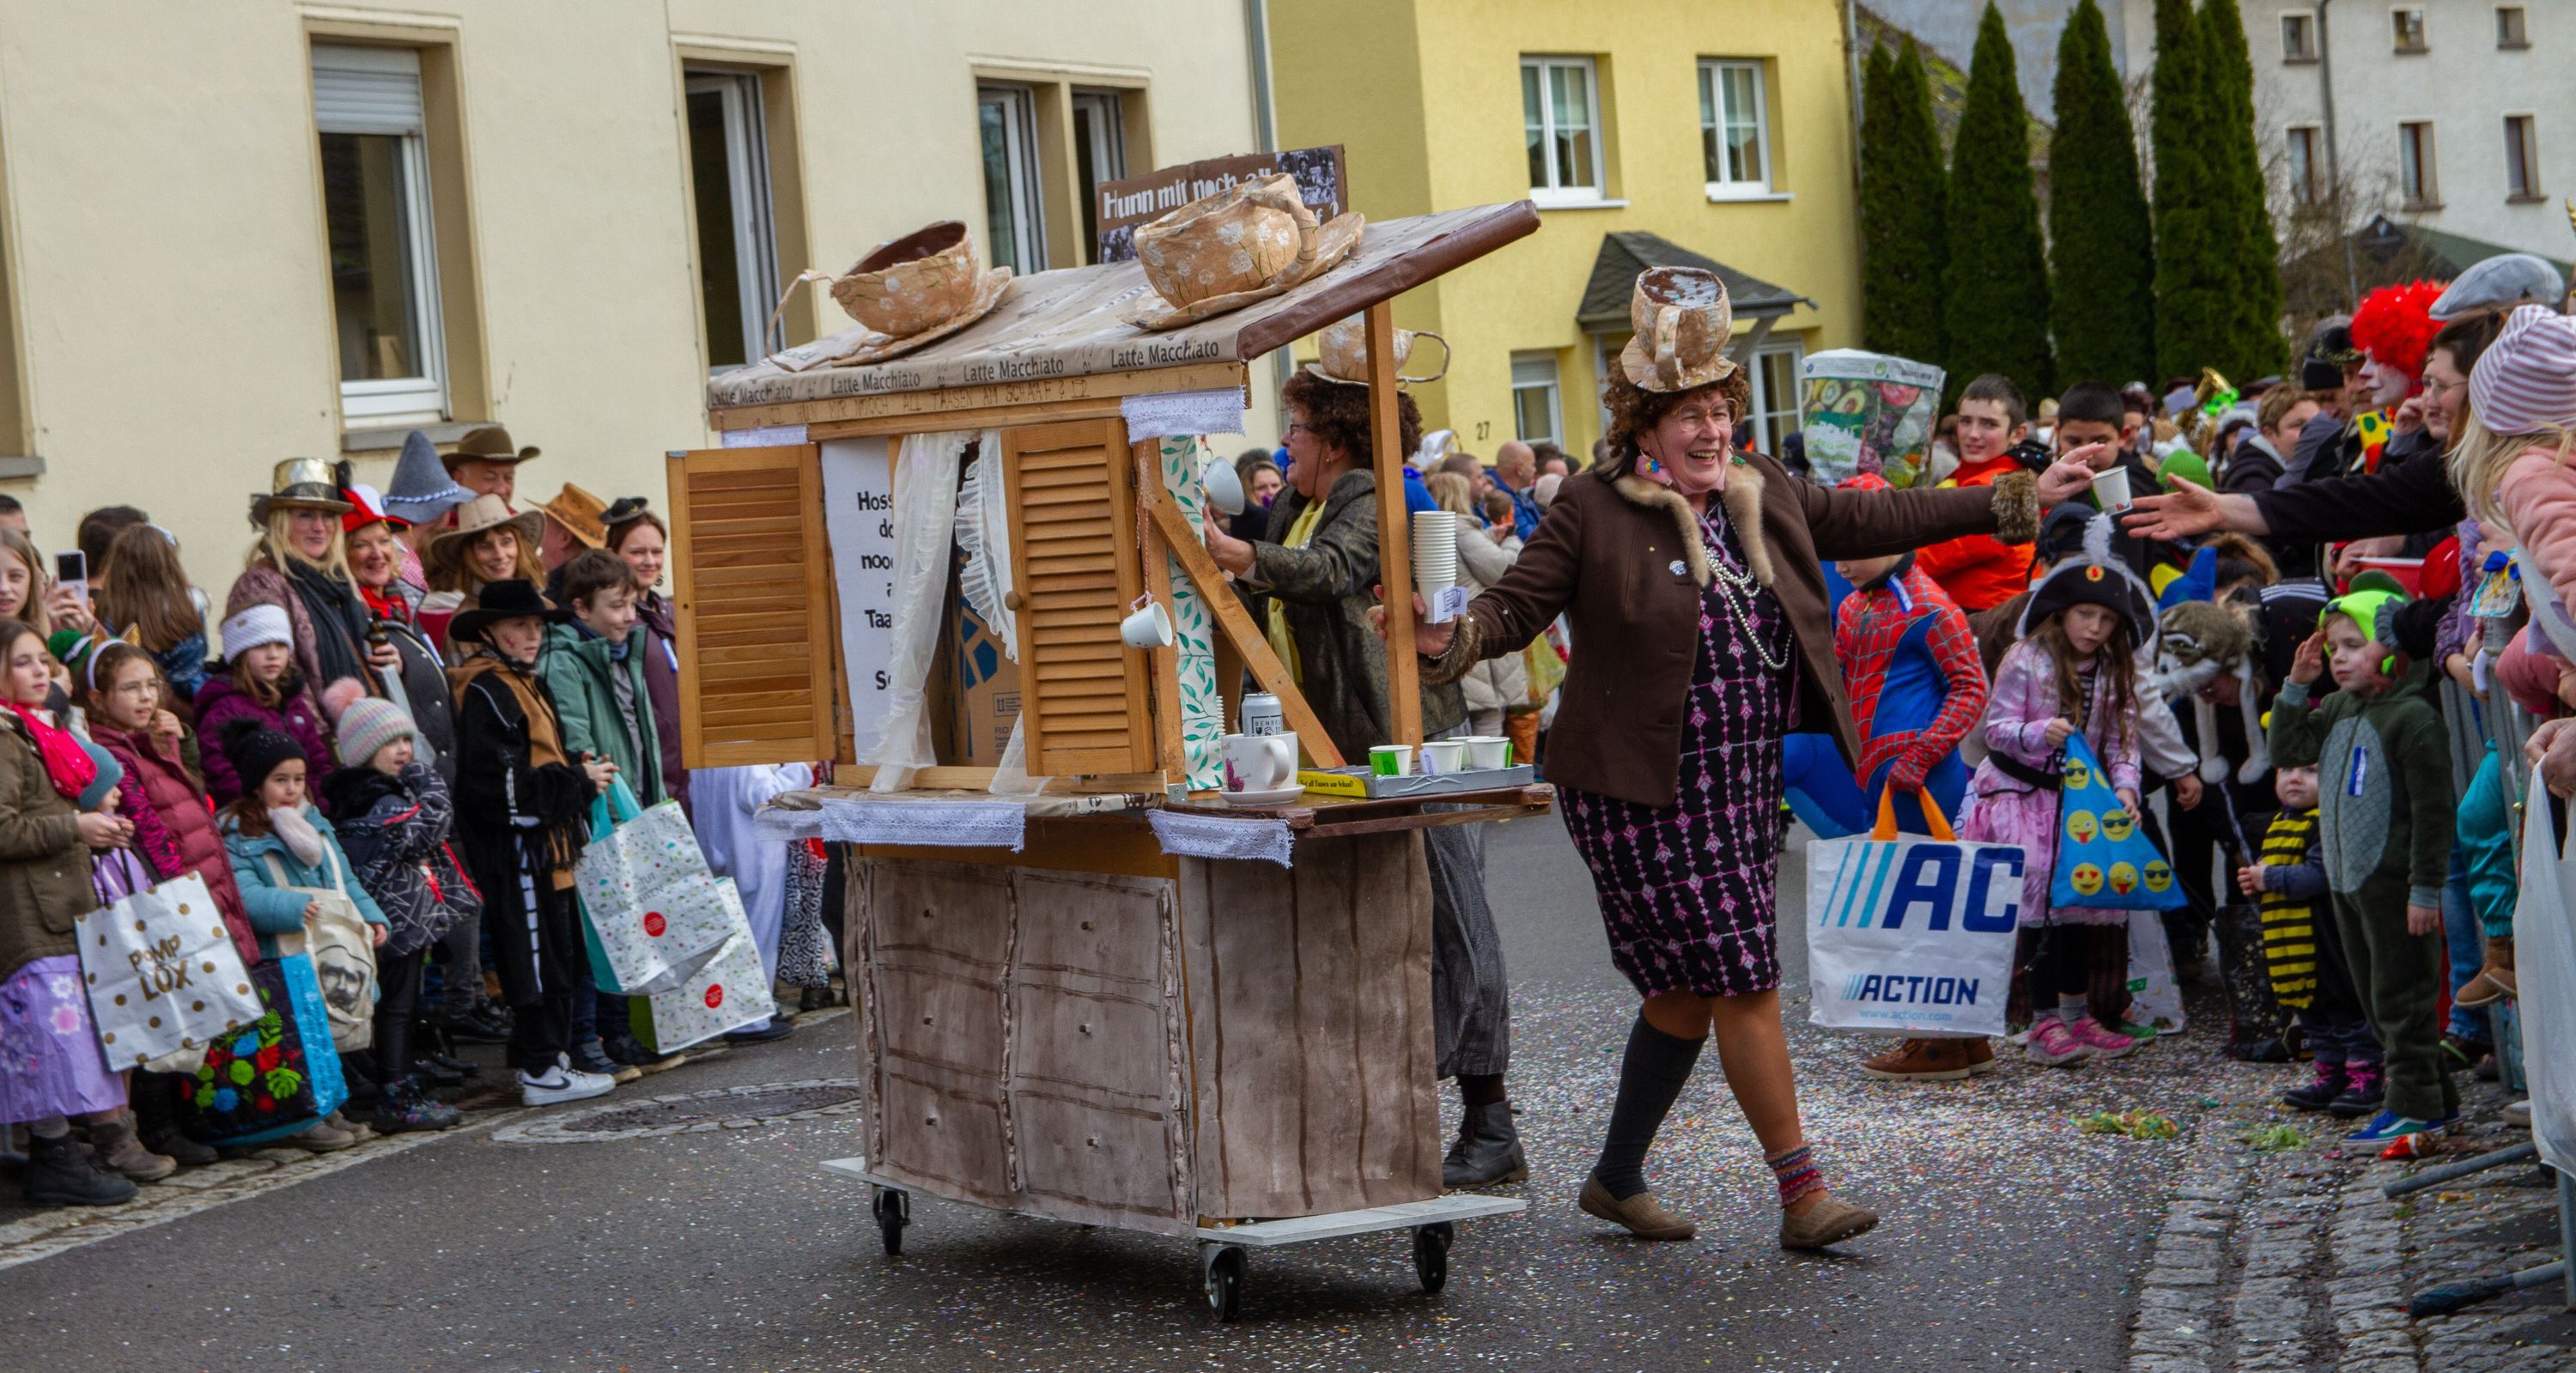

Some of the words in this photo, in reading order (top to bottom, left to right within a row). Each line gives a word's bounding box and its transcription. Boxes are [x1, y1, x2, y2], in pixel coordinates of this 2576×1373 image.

[1103, 189, 1154, 219] Hunn
[1157, 179, 1188, 210] mir
[1111, 348, 1144, 368] Latte
[1149, 340, 1218, 363] Macchiato
[963, 364, 994, 382] Latte
[999, 356, 1064, 379] Macchiato
[830, 377, 860, 395] Latte
[862, 371, 920, 391] Macchiato
[983, 386, 998, 406] AM
[1476, 421, 1490, 440] 27
[1880, 843, 2026, 933] AC
[1858, 975, 1979, 1005] ACTION
